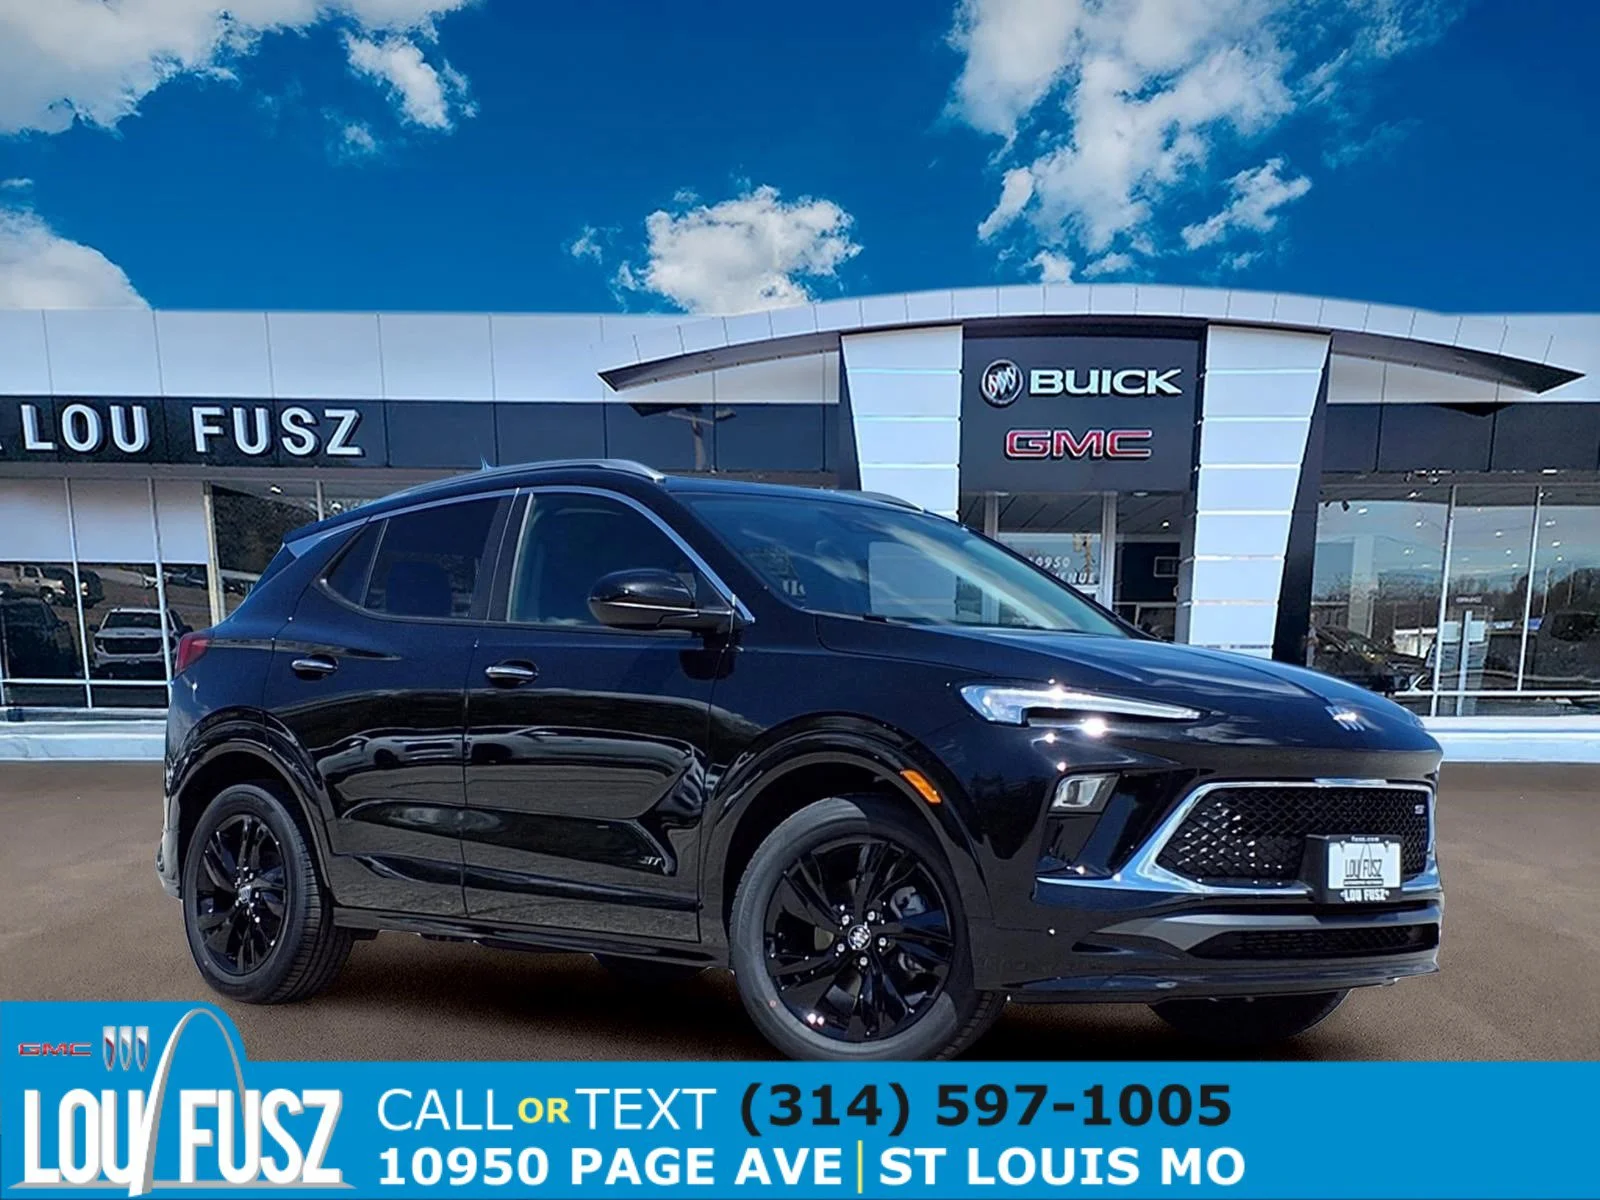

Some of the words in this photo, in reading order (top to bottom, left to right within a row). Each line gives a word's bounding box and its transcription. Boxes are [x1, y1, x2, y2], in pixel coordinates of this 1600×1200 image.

[1029, 369, 1183, 395] BUICK
[20, 403, 149, 453] LOU
[191, 406, 363, 456] FUSZ
[1006, 430, 1152, 458] GMC
[1345, 859, 1361, 878] LOU
[1363, 859, 1383, 878] FUSZ
[1344, 889, 1362, 902] LOU
[1363, 888, 1387, 901] FUSZ
